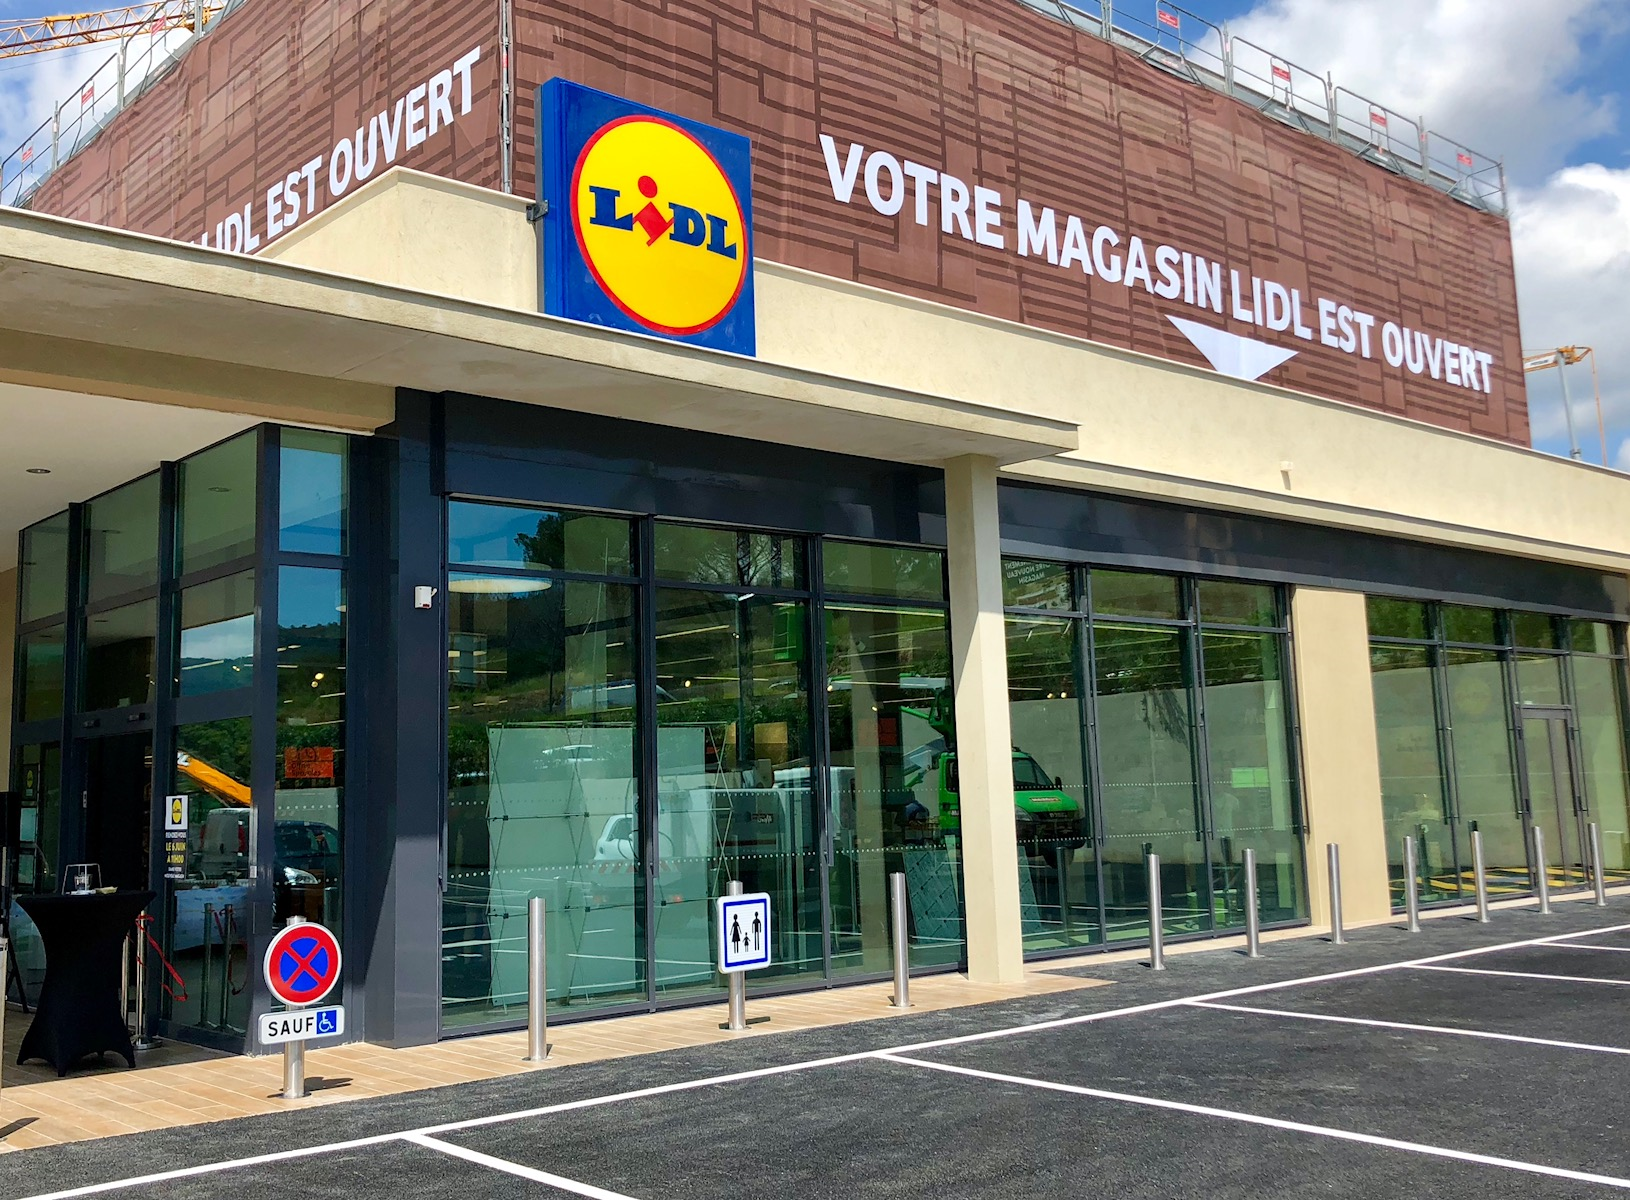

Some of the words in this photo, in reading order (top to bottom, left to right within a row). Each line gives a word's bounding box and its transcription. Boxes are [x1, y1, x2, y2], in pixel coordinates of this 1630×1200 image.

[266, 155, 323, 240] EST
[329, 45, 481, 197] OUVERT
[818, 133, 1005, 250] VOTRE
[1017, 198, 1223, 314] MAGASIN
[1231, 268, 1312, 341] LIDL
[1318, 297, 1374, 359] EST
[1381, 321, 1493, 394] OUVERT
[268, 1016, 315, 1037] SAUF
